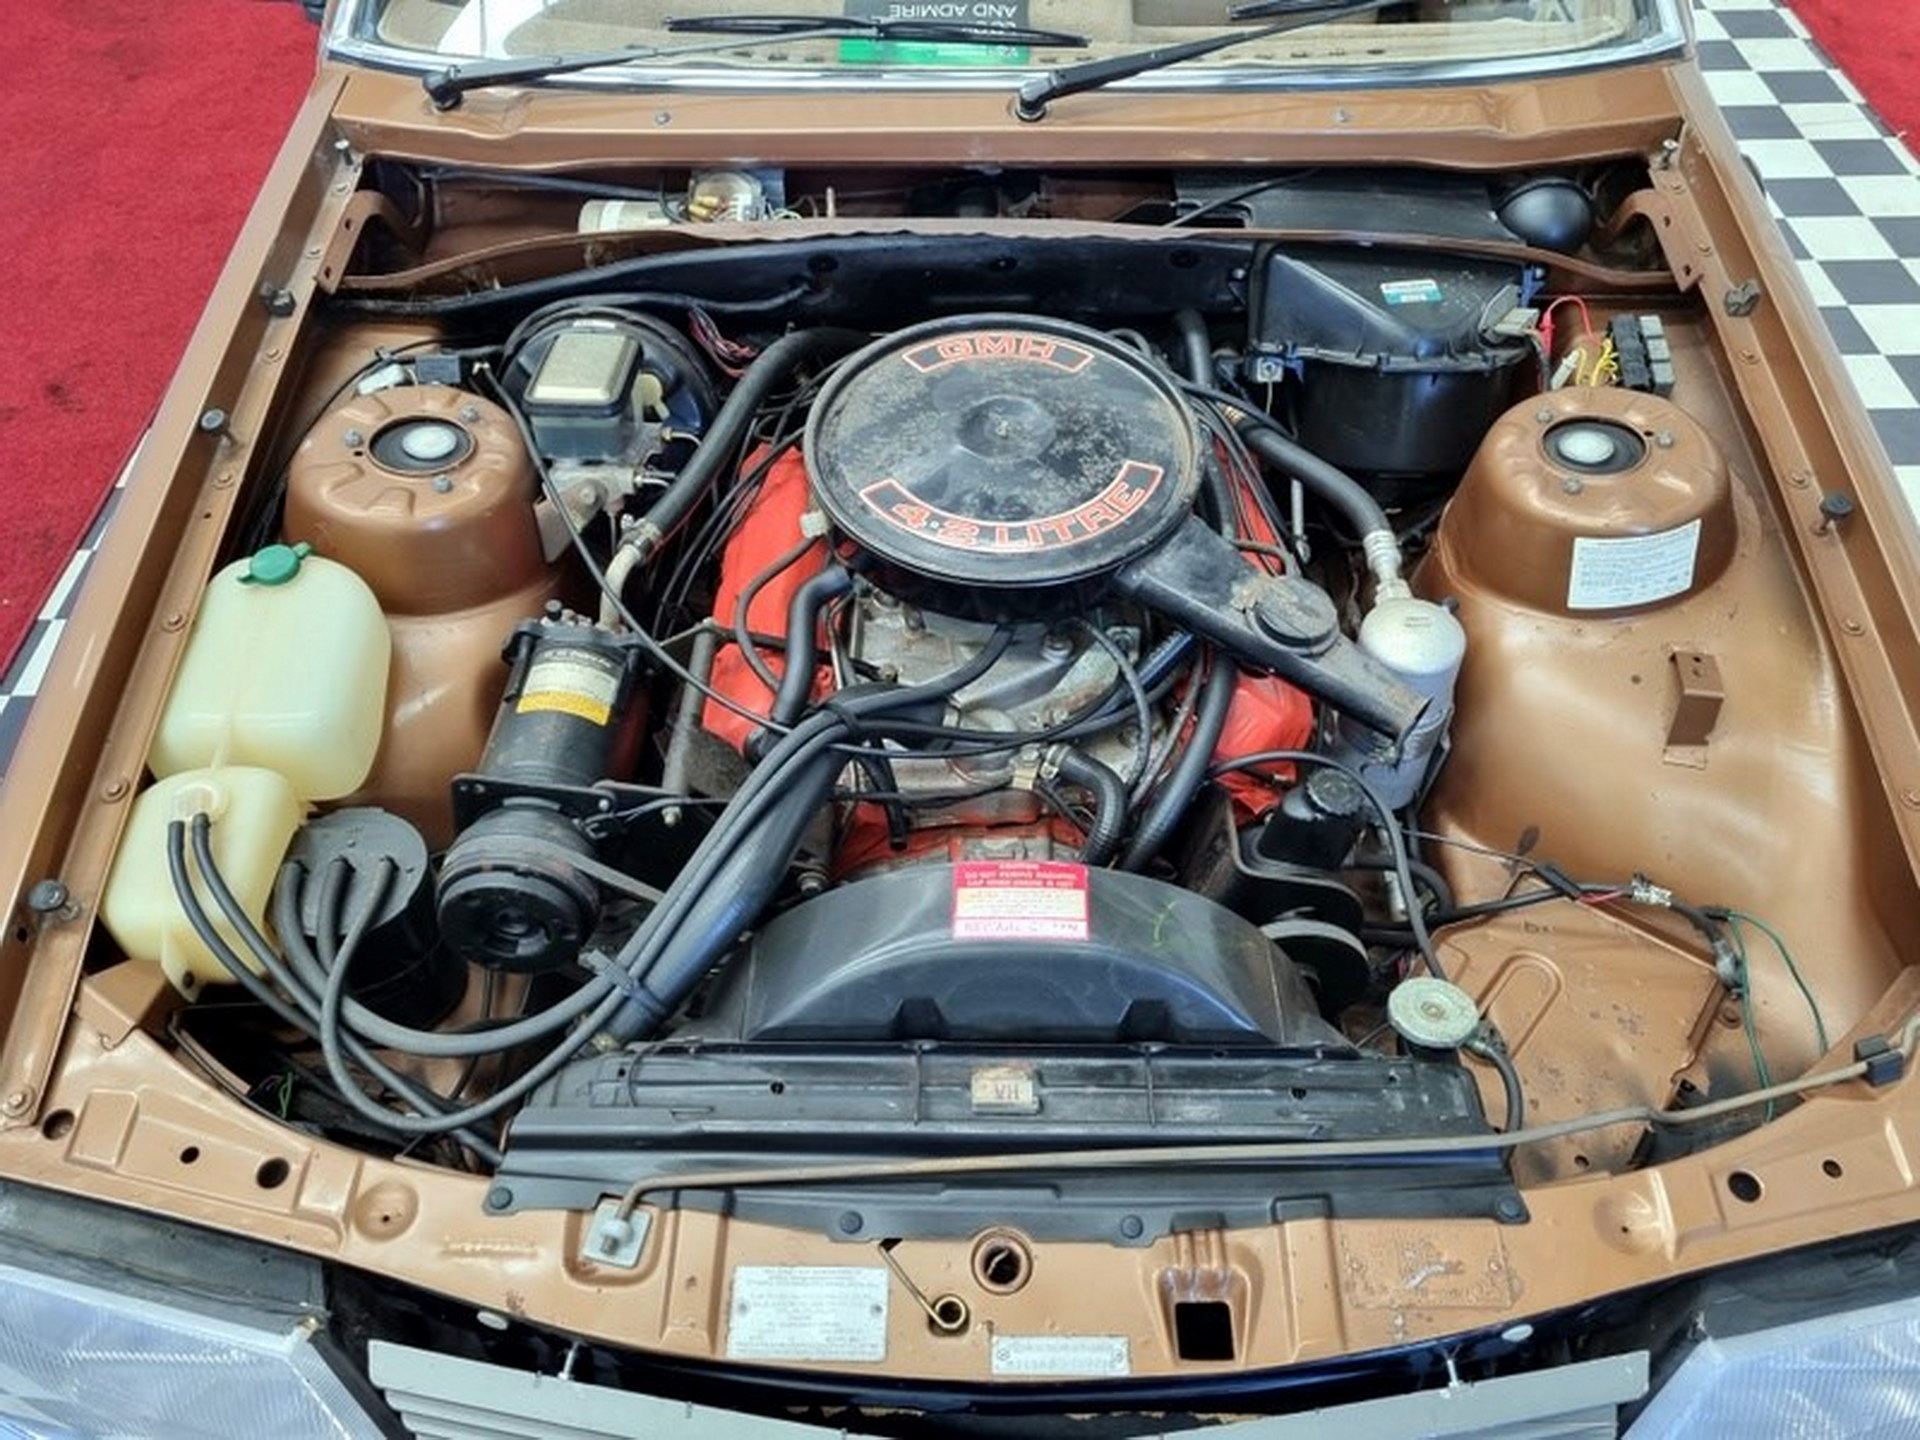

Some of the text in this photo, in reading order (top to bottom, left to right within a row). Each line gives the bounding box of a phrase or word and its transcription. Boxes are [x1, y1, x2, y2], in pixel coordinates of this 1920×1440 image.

[889, 4, 1018, 18] AND ADMIRE
[937, 335, 1057, 359] GMH
[995, 481, 1146, 547] LITRE
